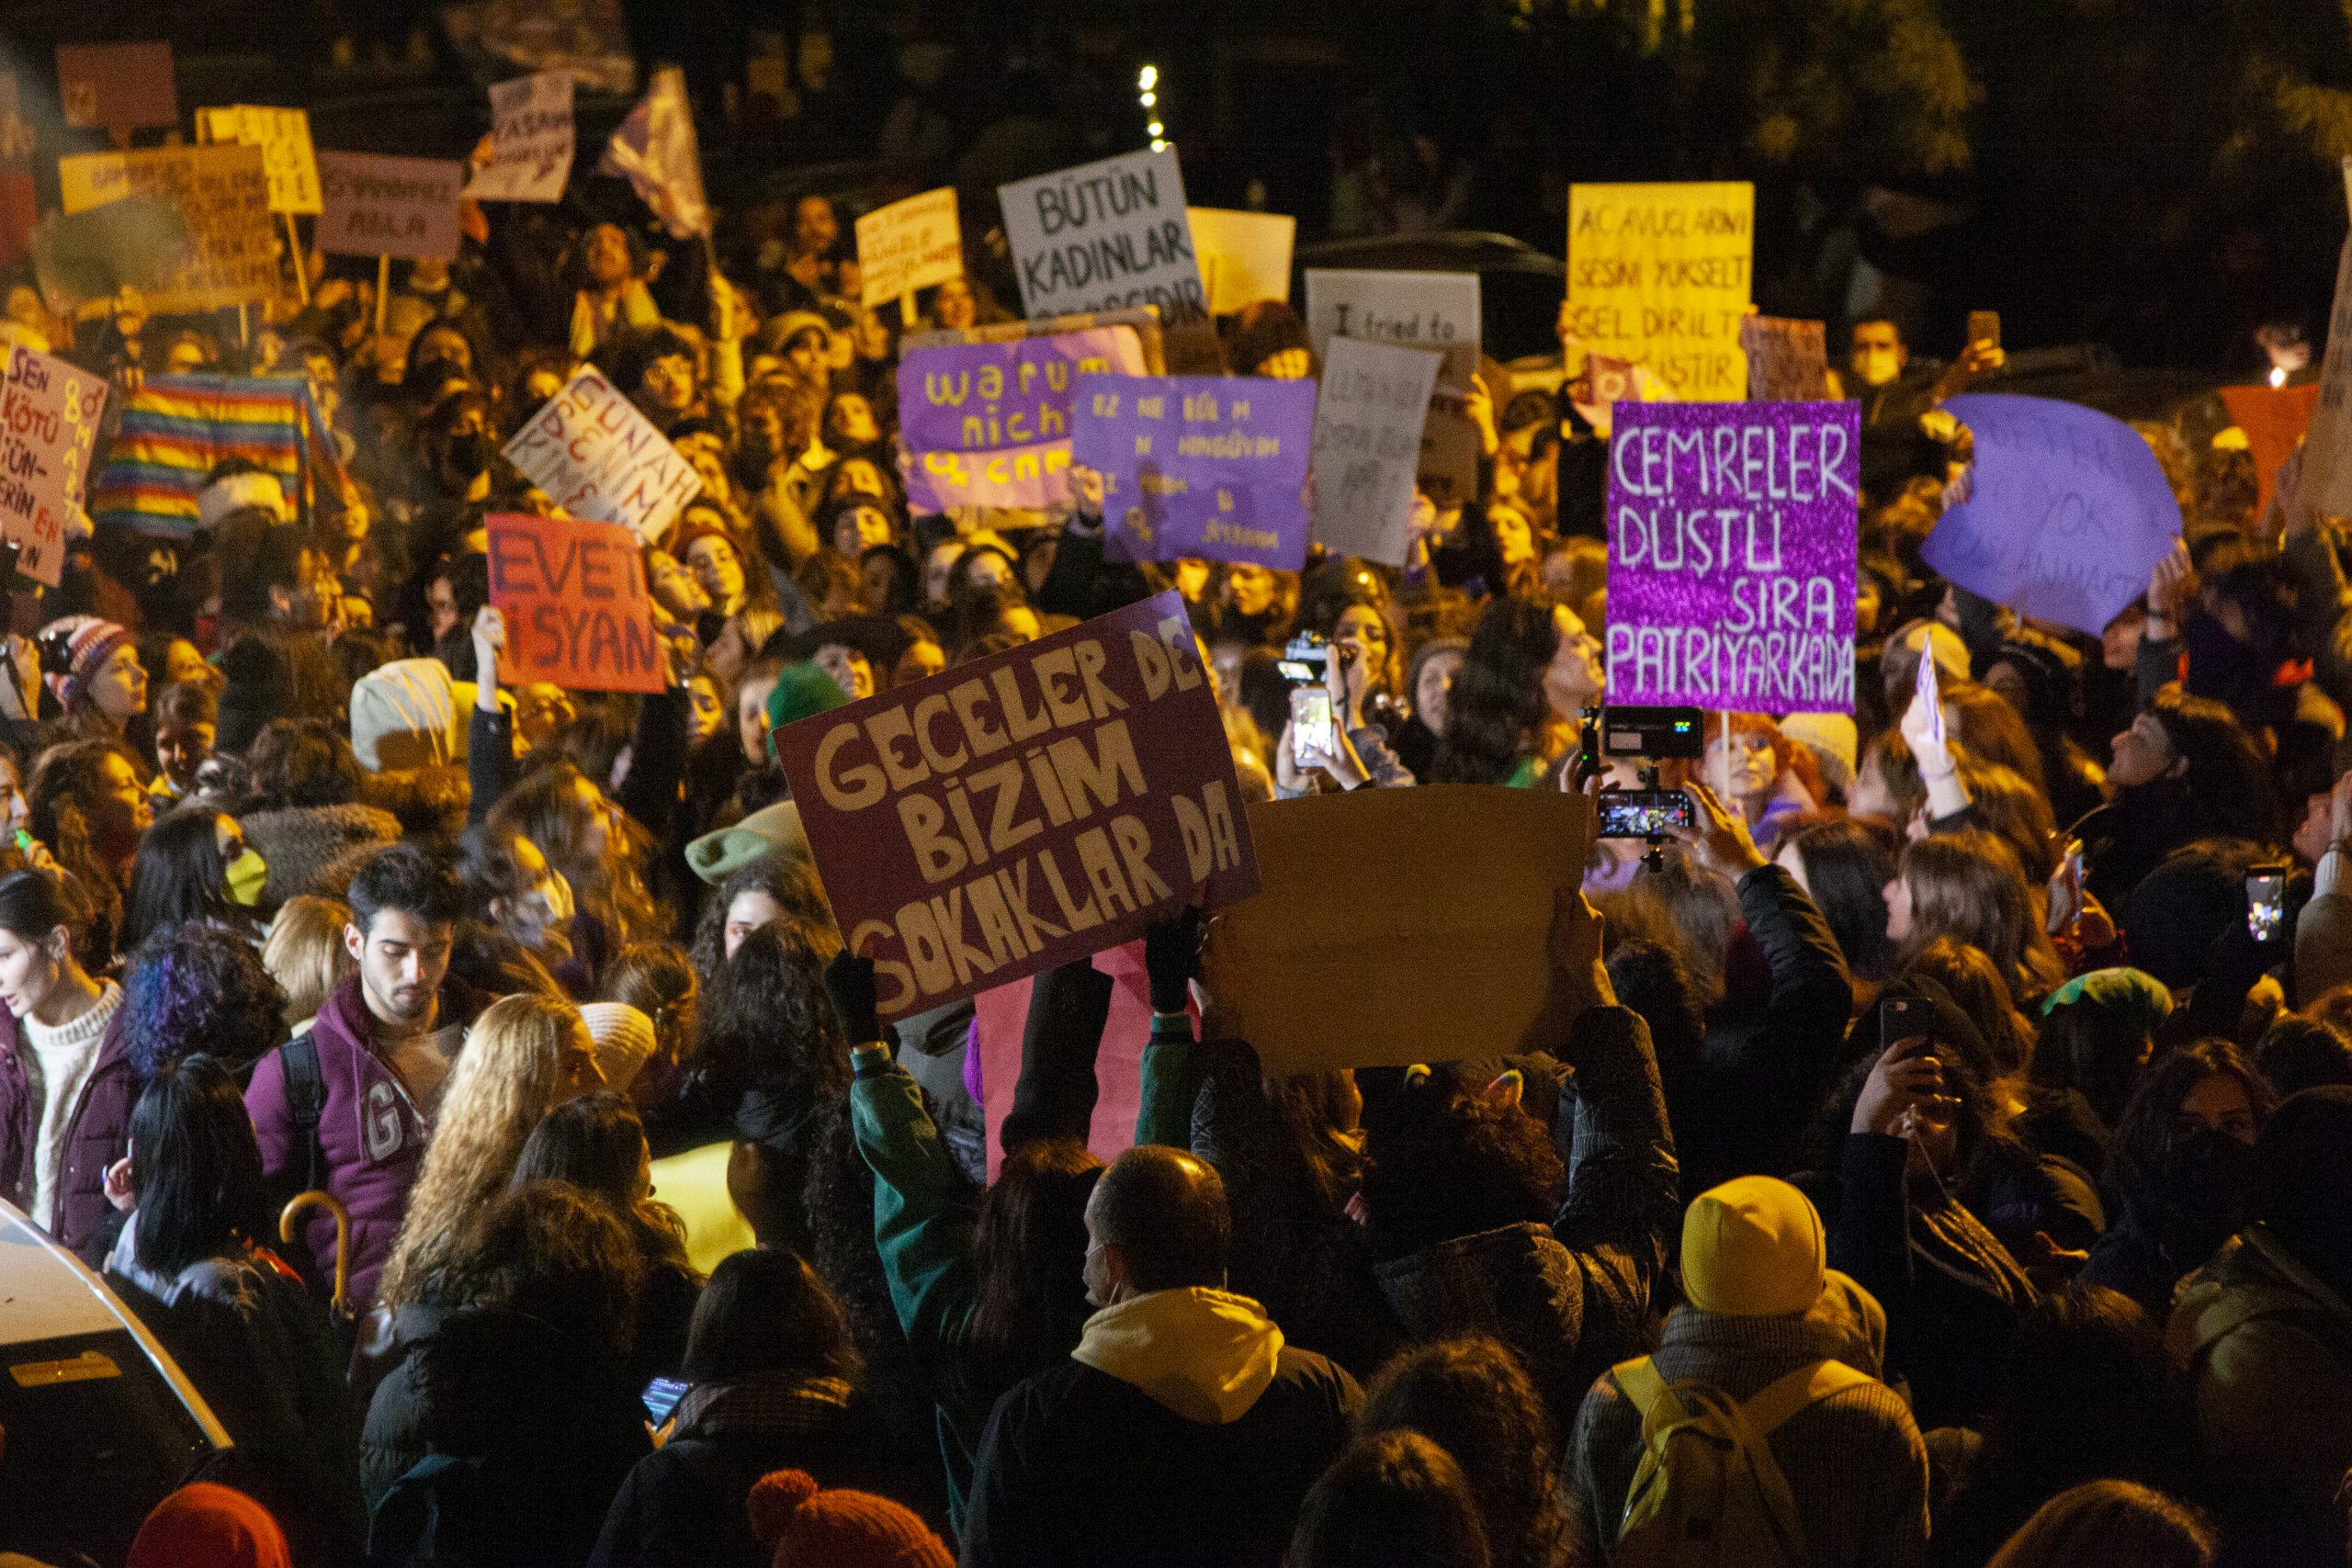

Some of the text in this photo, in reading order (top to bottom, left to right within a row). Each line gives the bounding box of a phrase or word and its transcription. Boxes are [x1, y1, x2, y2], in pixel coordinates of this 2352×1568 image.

[1035, 165, 1159, 235] BÜTÜN
[1022, 219, 1194, 301] KADINLAR
[8, 346, 50, 393] SEN
[3, 388, 60, 446] KÖTÜ
[963, 401, 1076, 447] nich
[1614, 424, 1856, 502] CEMRELER
[491, 528, 643, 600] EVET
[1618, 497, 1782, 579] DÜŞTÜ
[1723, 576, 1836, 632] SIRA
[1607, 623, 1857, 704] PATRİYARKADA
[814, 615, 1202, 811] GECELER DE
[896, 718, 1148, 884] BİZİM
[850, 780, 1240, 1014] SOKAKLAR DA
